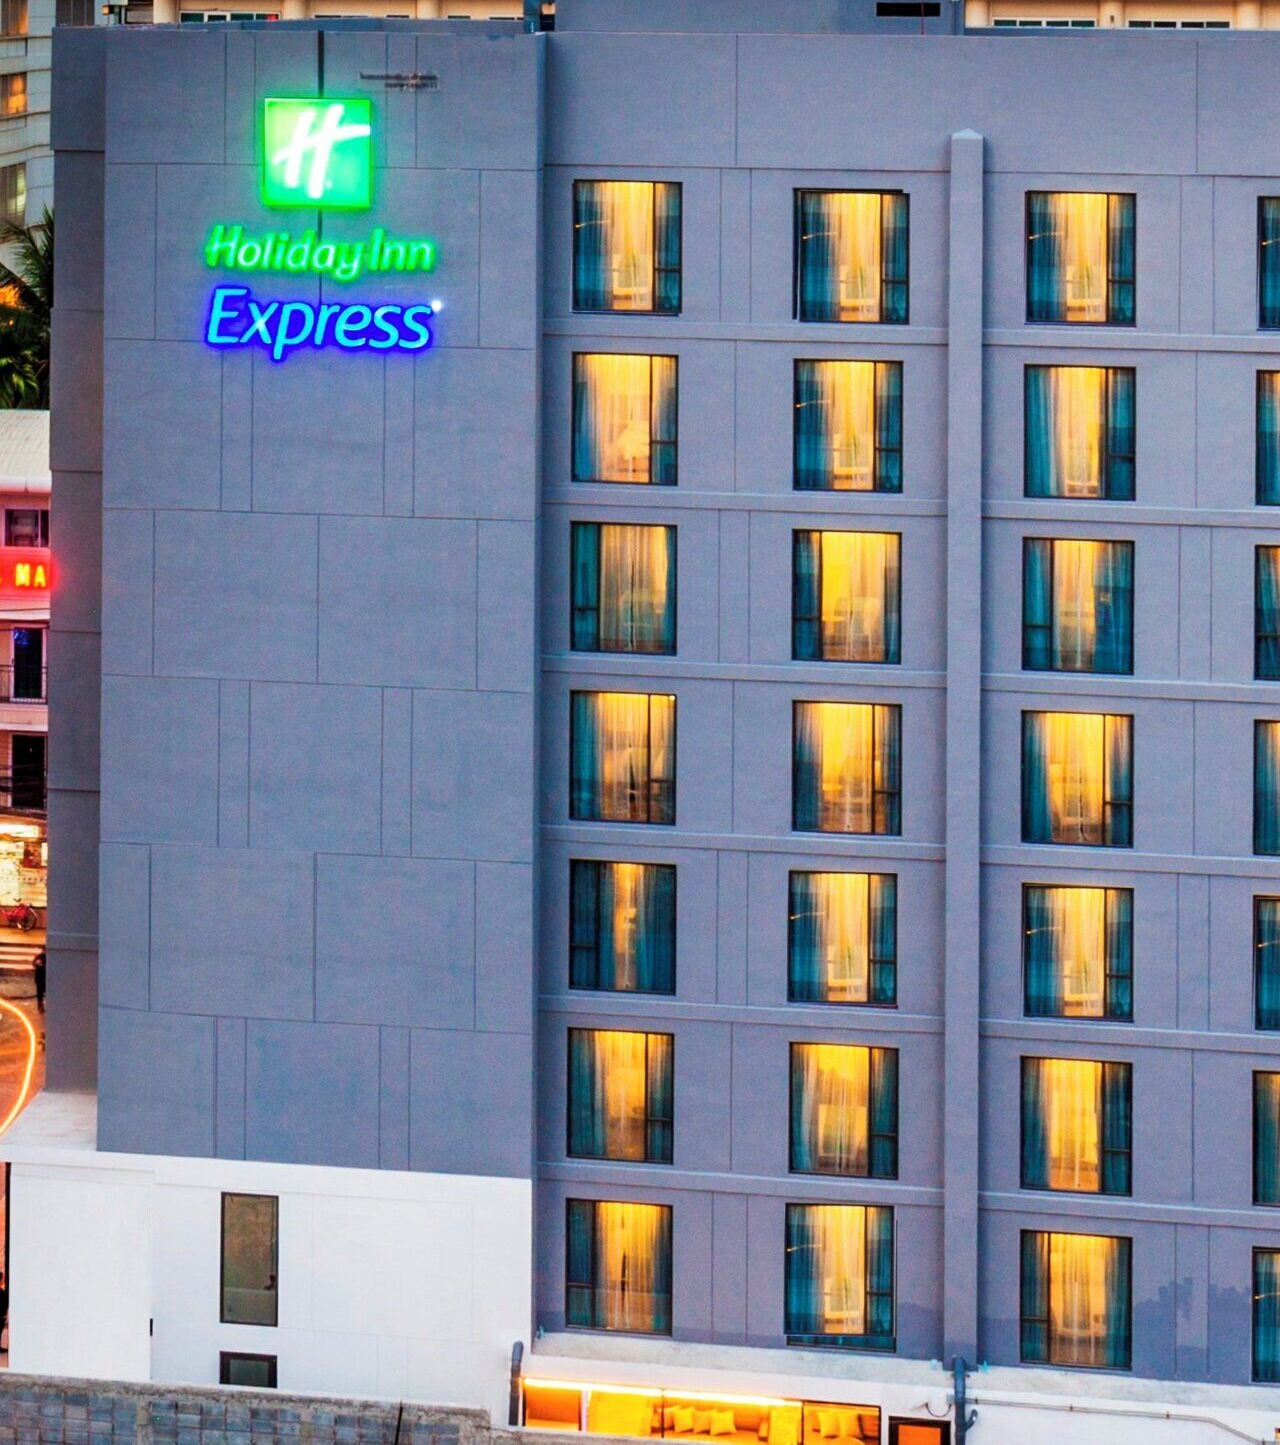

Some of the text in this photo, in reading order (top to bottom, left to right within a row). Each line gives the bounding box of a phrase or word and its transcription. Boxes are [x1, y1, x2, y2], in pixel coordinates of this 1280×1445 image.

[205, 224, 435, 282] Holiday Inn
[206, 287, 433, 361] Express
